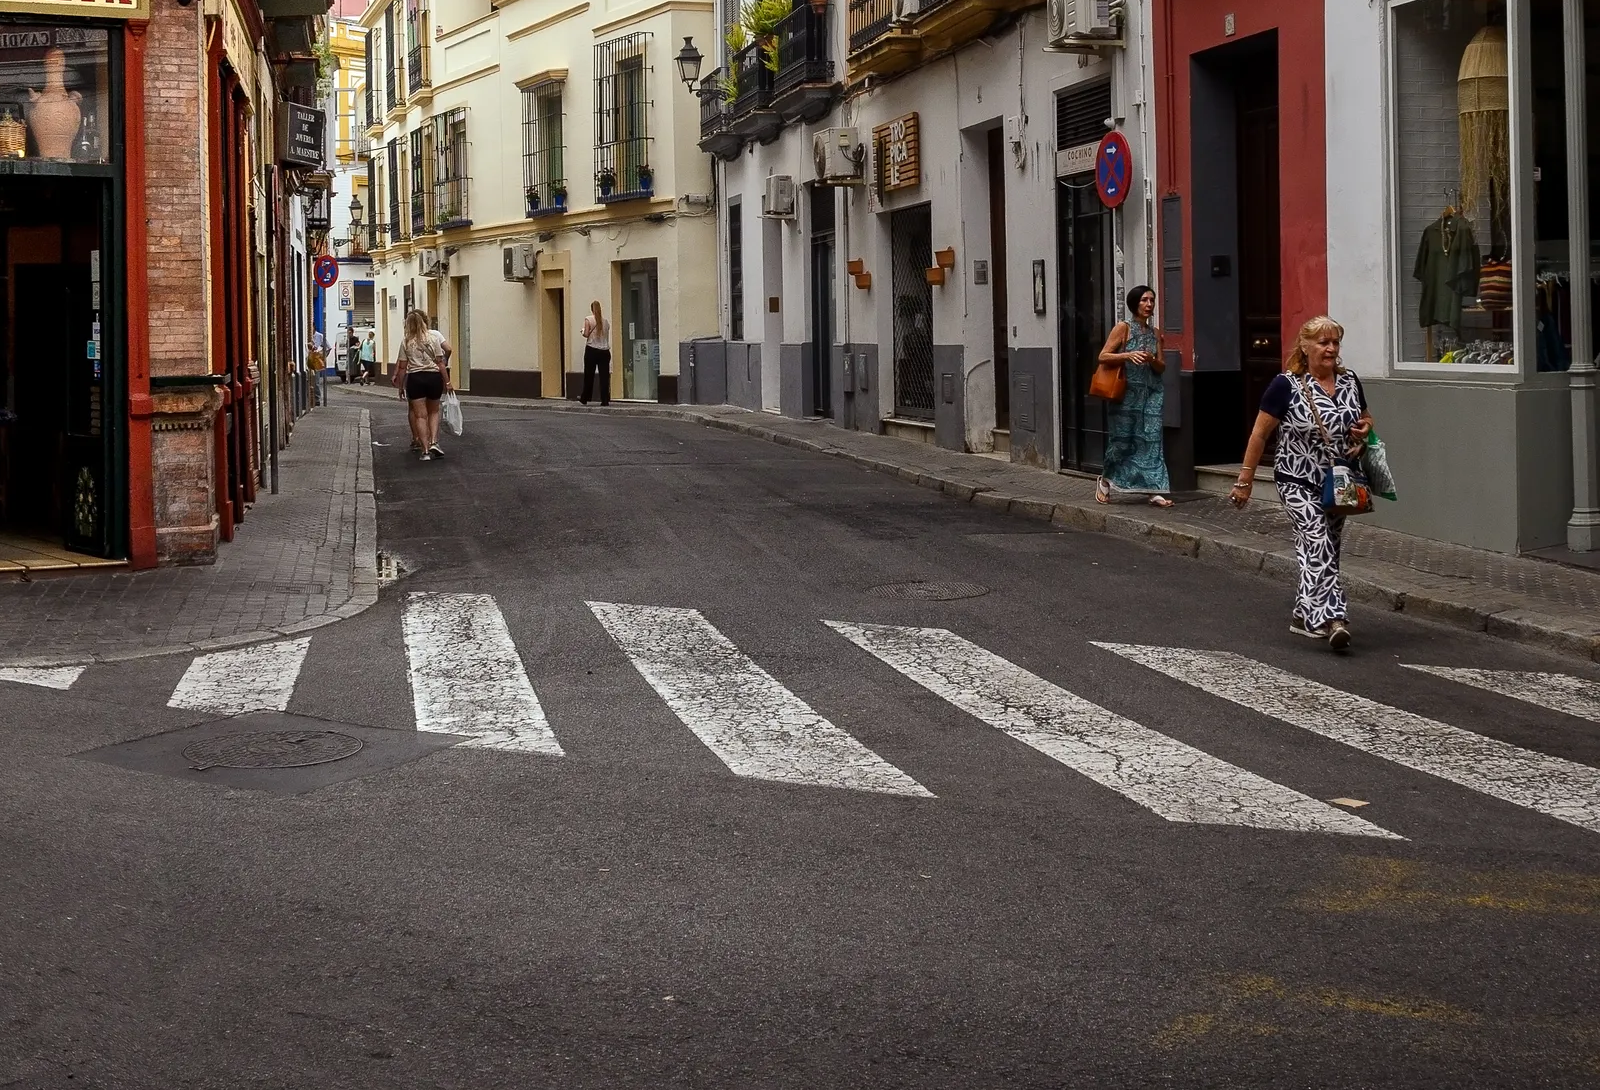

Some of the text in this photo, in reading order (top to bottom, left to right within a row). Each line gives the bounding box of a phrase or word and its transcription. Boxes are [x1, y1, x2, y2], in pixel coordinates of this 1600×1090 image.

[297, 111, 315, 123] TALLER
[302, 123, 309, 132] DE
[890, 120, 905, 143] TRO
[296, 147, 320, 160] MAESTRE
[890, 141, 908, 164] PICA
[1068, 147, 1092, 160] COCHINO
[890, 165, 900, 186] LE
